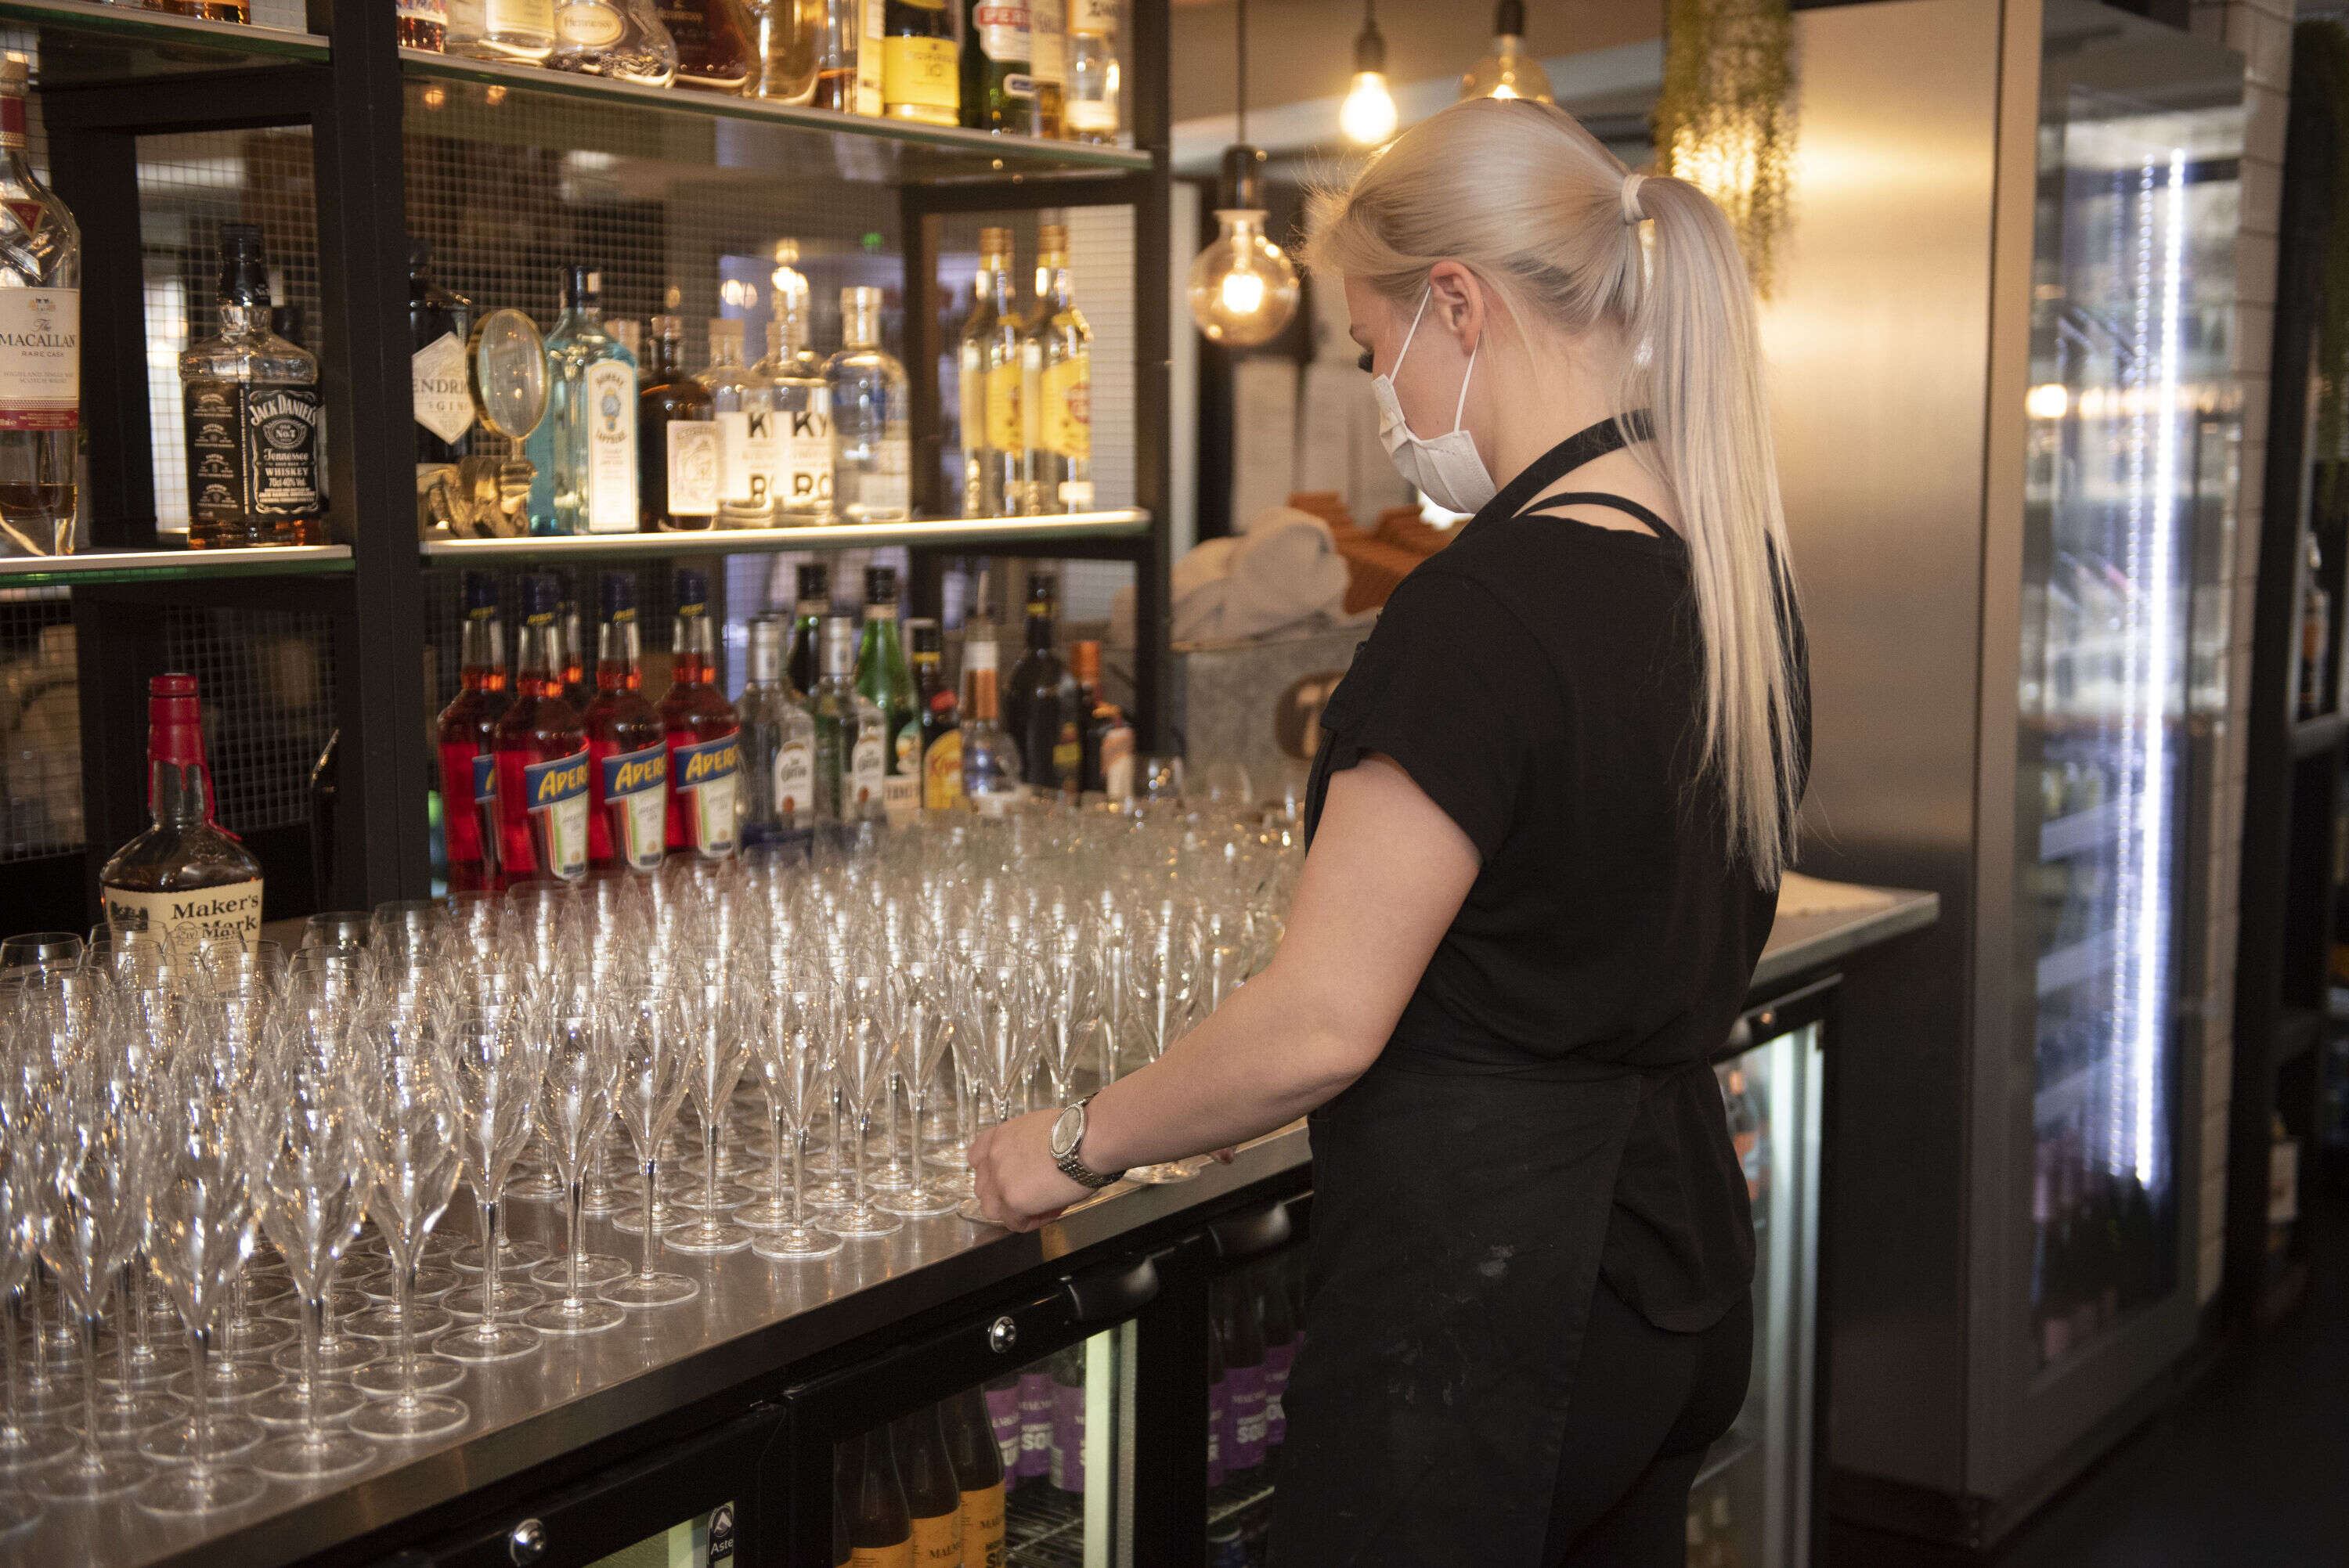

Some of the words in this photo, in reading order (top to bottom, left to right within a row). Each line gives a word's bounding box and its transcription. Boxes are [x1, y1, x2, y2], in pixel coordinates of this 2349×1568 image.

[0, 333, 76, 348] MACALLAN
[248, 398, 279, 427] JACK
[263, 448, 309, 461] Tennessee
[265, 467, 309, 477] WHISKEY
[171, 894, 259, 921] Maker's
